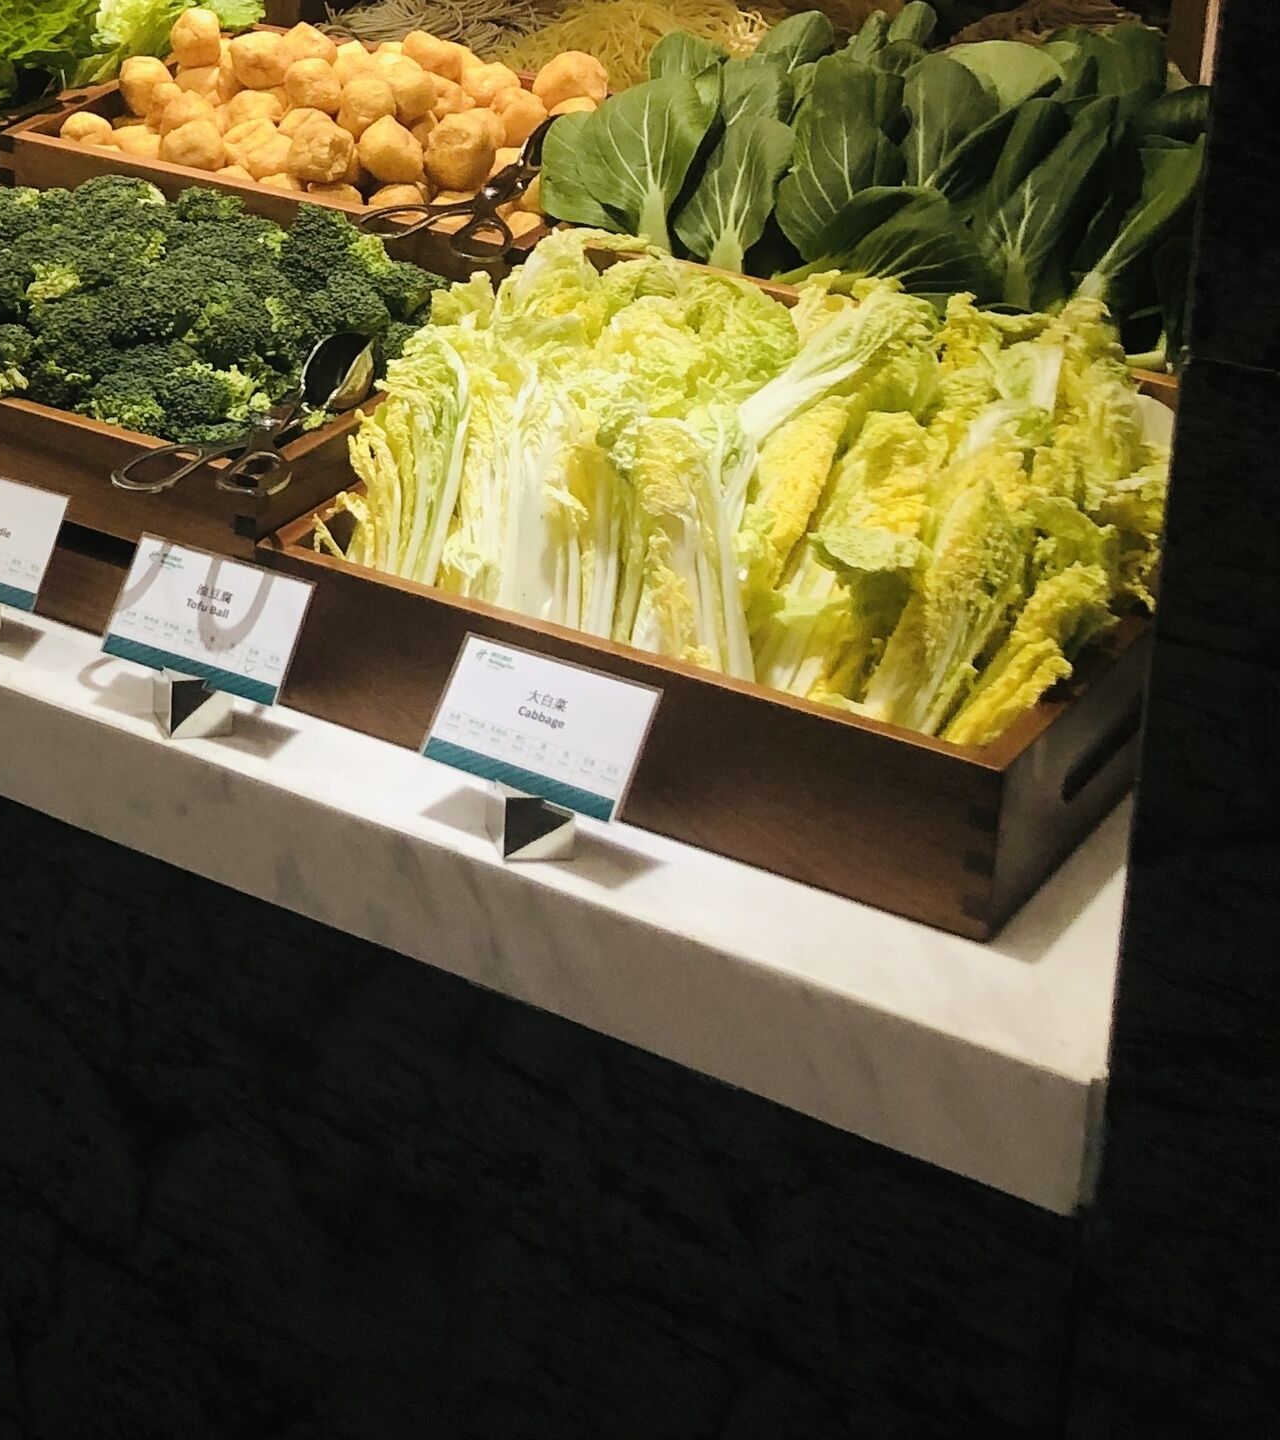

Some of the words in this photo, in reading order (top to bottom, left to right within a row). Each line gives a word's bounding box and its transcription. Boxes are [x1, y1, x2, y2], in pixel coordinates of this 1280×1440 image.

[186, 597, 207, 613] Tofu
[209, 604, 230, 619] Ball
[526, 689, 568, 713] 大白菜
[518, 705, 566, 730] Cabbage
